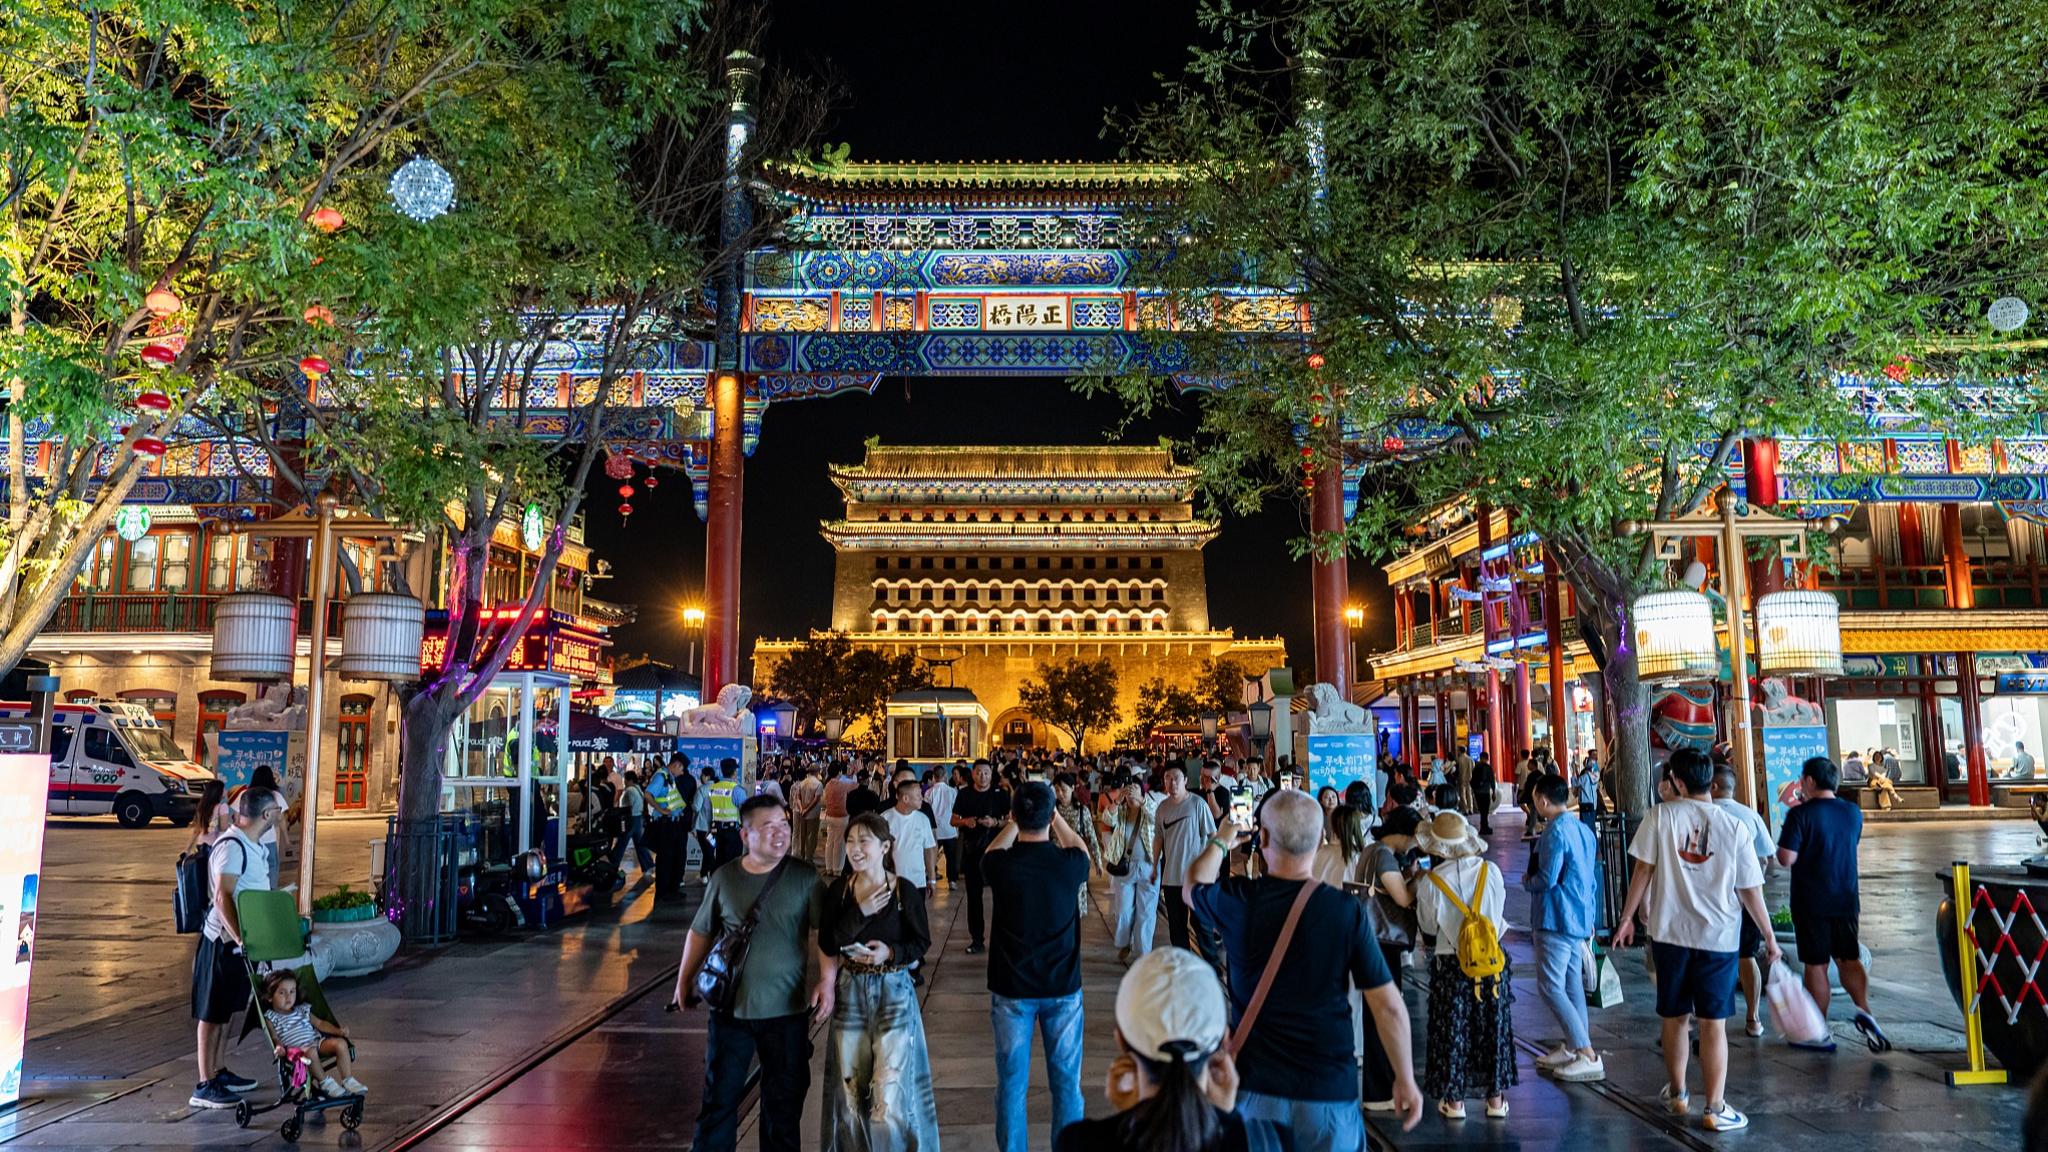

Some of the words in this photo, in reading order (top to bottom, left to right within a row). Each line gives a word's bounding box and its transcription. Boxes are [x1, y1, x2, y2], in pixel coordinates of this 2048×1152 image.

[989, 304, 1062, 326] 正陽橋
[2007, 676, 2048, 691] HEYT
[127, 706, 145, 717] 999
[571, 739, 592, 747] POLICE
[1778, 745, 1816, 757] 寻味前门
[1324, 755, 1363, 766] 寻味前门
[94, 774, 118, 784] 999
